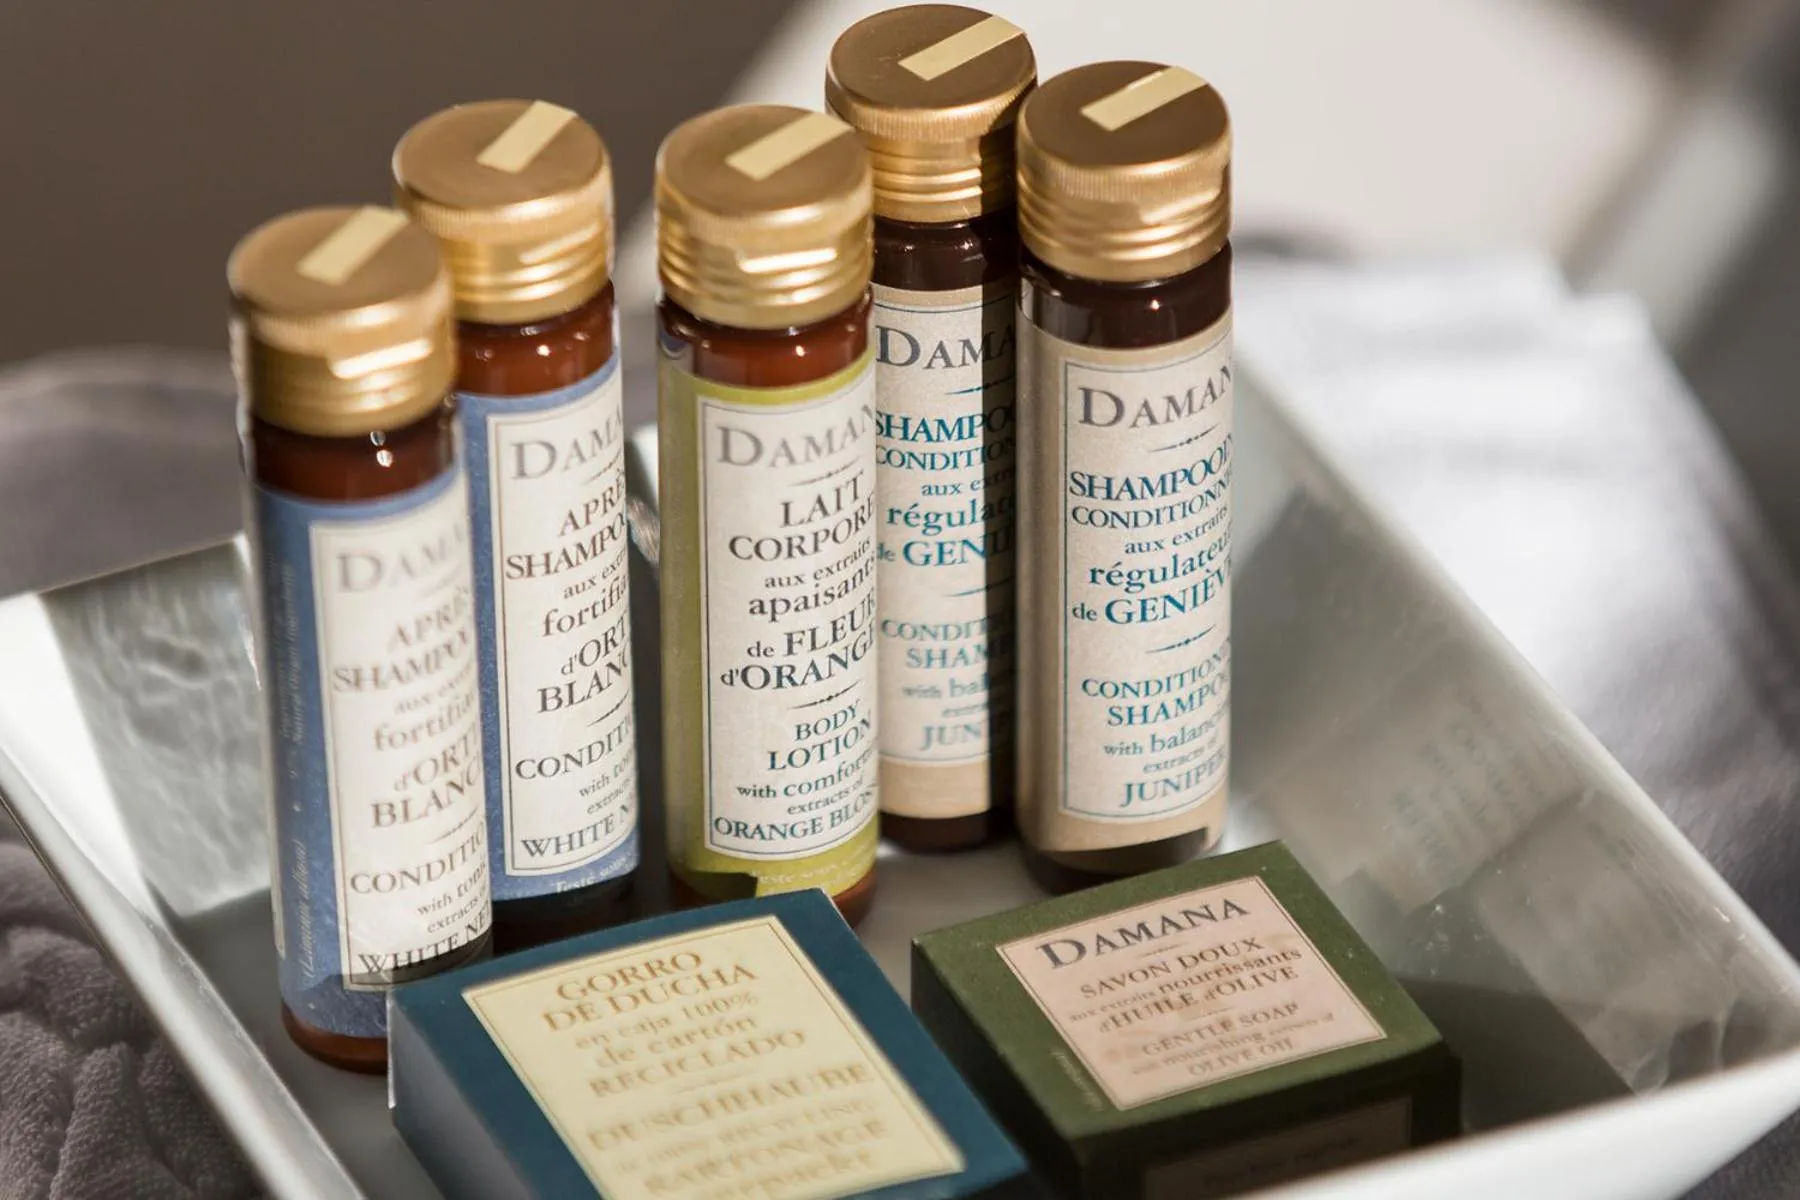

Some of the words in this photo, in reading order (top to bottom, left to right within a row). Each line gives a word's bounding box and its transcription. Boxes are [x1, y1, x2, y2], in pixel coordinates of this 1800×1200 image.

[780, 468, 864, 529] LAIT
[921, 482, 961, 498] aux
[1124, 538, 1166, 554] aux
[564, 575, 597, 599] aux
[764, 573, 806, 589] aux
[1072, 602, 1098, 622] de
[747, 640, 775, 658] de
[794, 698, 861, 741] BODY
[1104, 741, 1144, 757] with
[579, 773, 610, 797] with
[736, 784, 777, 799] with
[521, 814, 614, 858] WHITE
[713, 815, 824, 842] ORANGE
[417, 892, 452, 915] with
[1035, 898, 1251, 970] DAMANA
[357, 930, 460, 977] WHITE
[1078, 960, 1173, 1000] SAVON
[1176, 936, 1267, 972] DOUX
[556, 950, 704, 1001] GORRO
[1159, 947, 1304, 996] nourrissants
[1204, 965, 1300, 1003] d'OLIVE
[543, 1001, 602, 1033] DE
[607, 963, 760, 1015] DUCHA
[1141, 1014, 1235, 1057] GENTLE
[1239, 1001, 1300, 1029] SOAP
